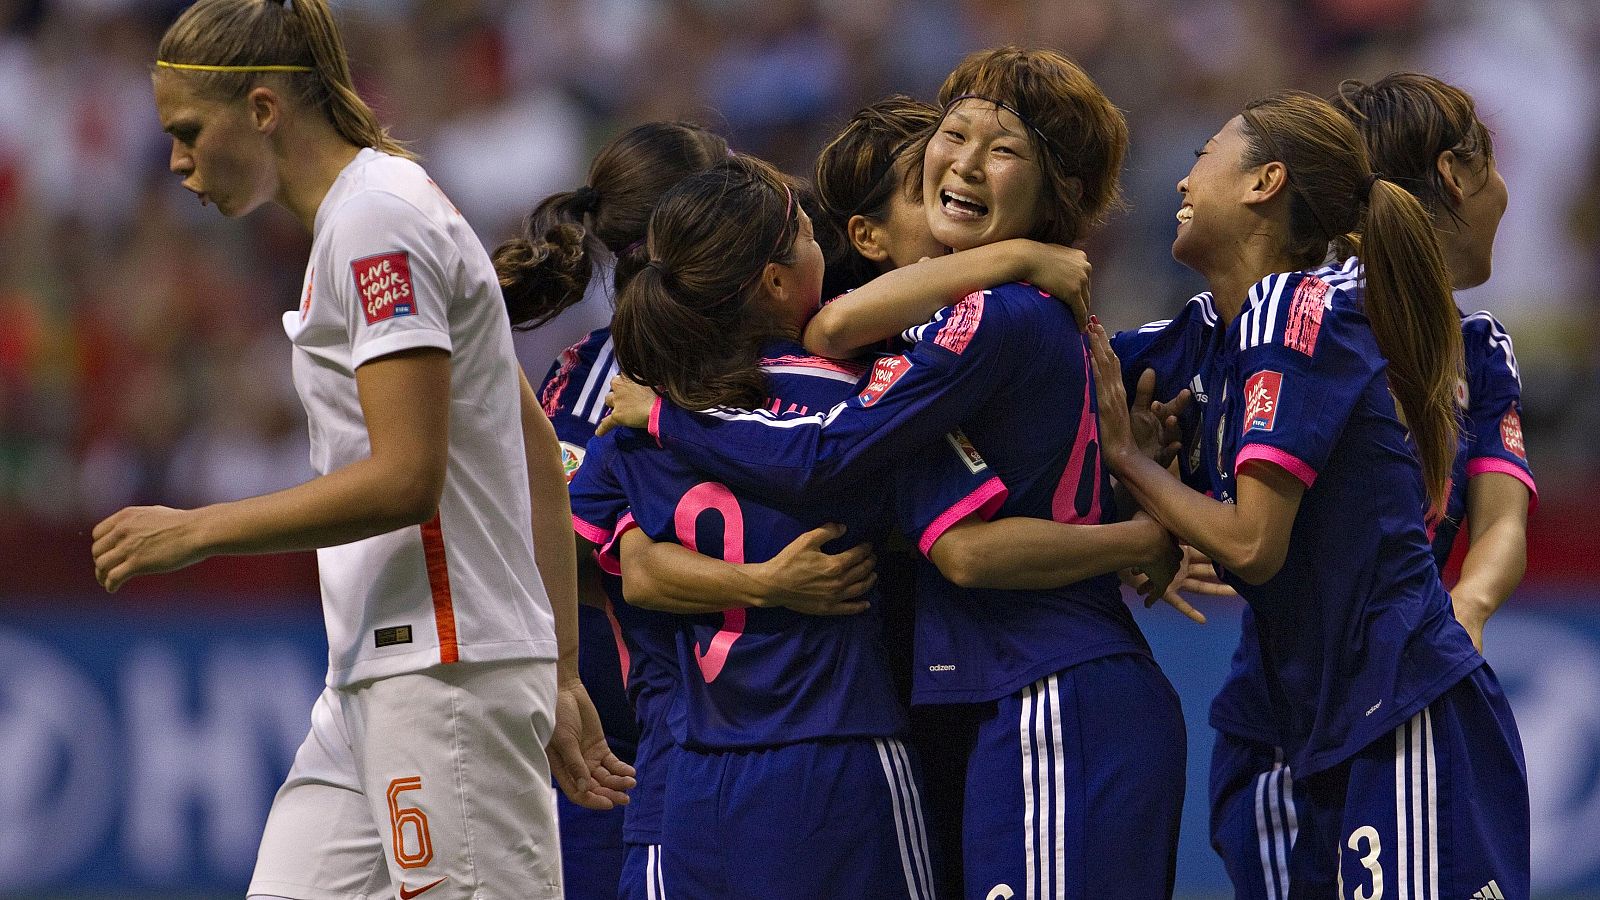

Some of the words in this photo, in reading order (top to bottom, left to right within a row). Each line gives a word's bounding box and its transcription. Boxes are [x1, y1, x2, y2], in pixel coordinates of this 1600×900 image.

[360, 259, 392, 286] LIVE
[363, 272, 405, 300] YOUR
[367, 283, 410, 317] GOALS
[875, 368, 894, 383] YOUR
[878, 357, 901, 369] LIVE
[1252, 419, 1266, 427] FIFA
[673, 481, 749, 684] 9
[386, 775, 434, 869] 6
